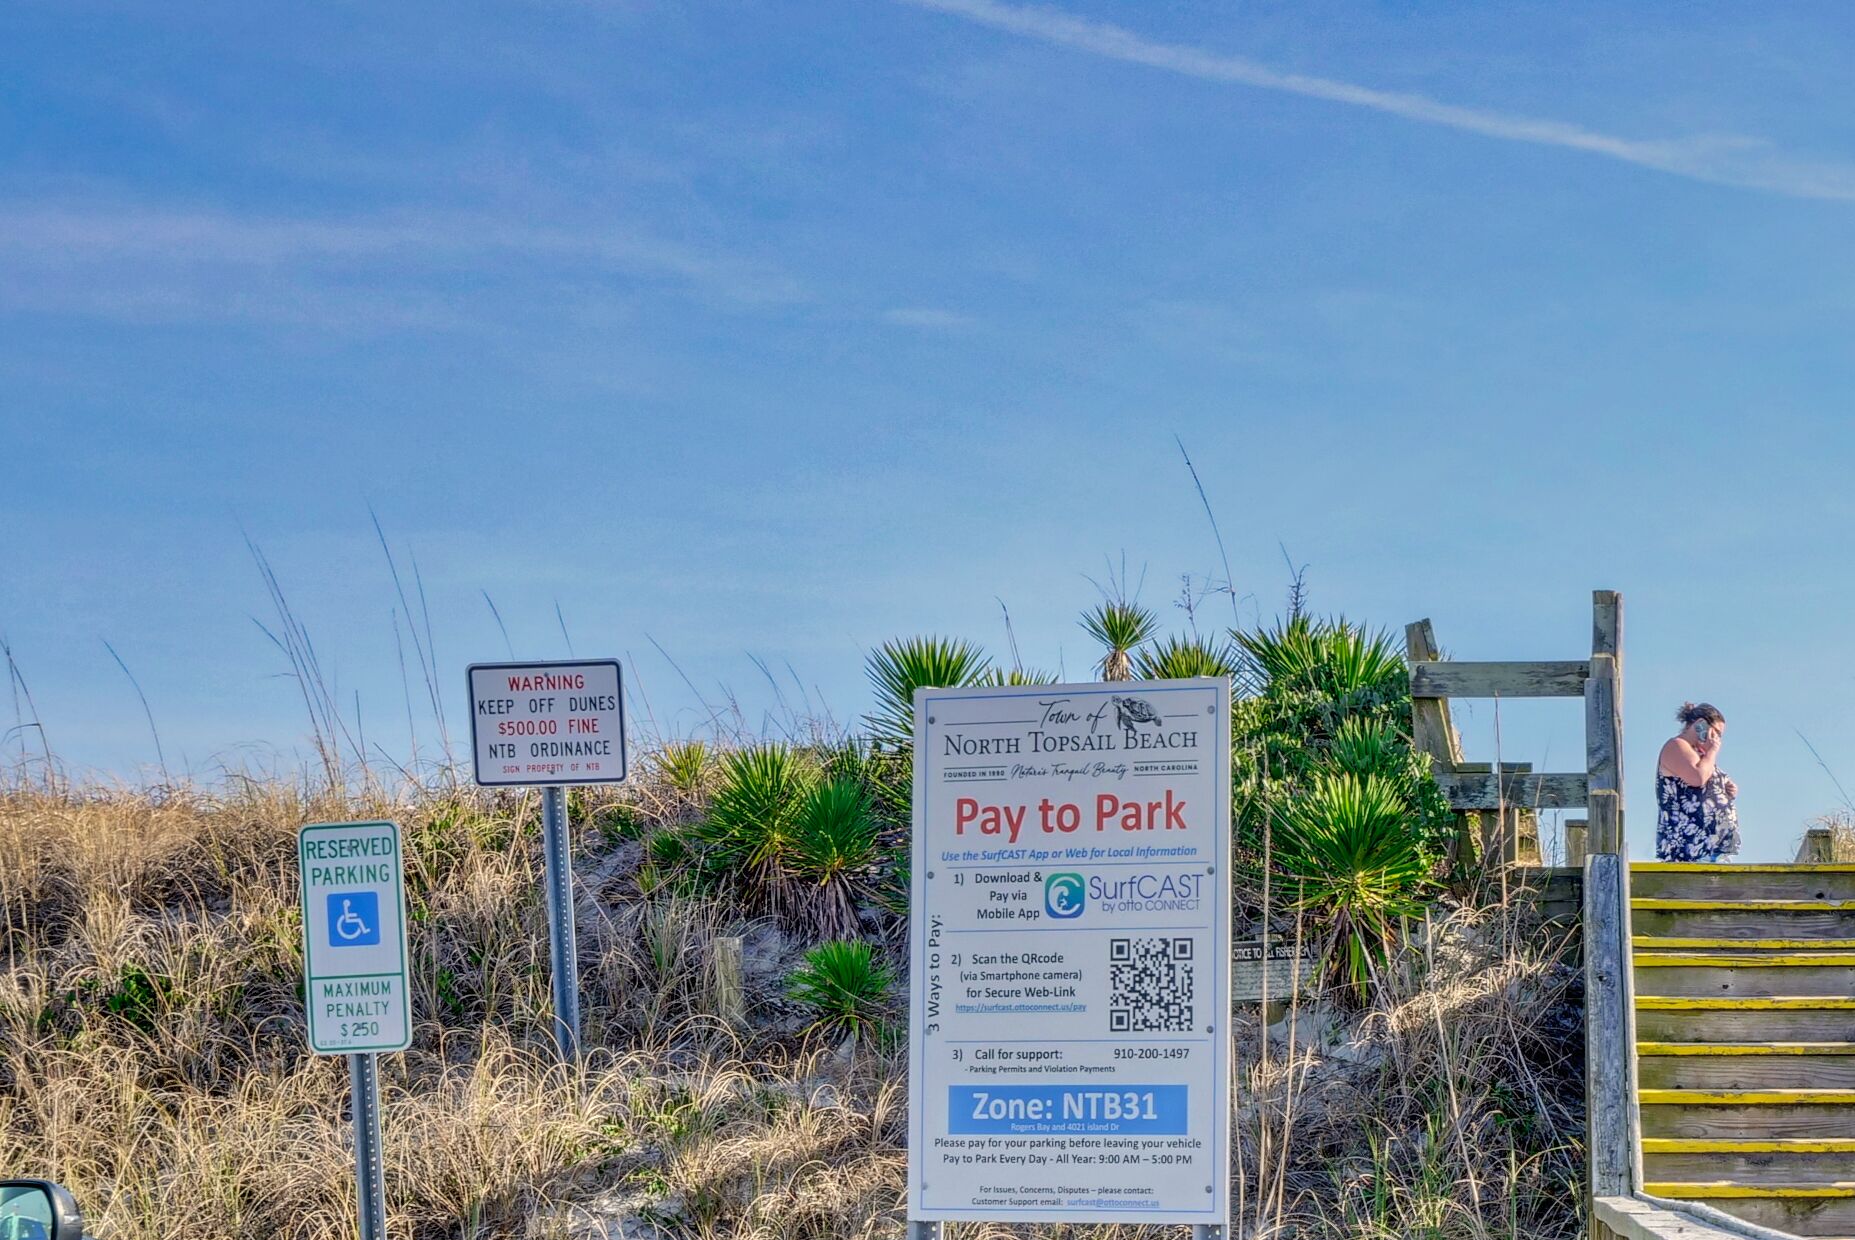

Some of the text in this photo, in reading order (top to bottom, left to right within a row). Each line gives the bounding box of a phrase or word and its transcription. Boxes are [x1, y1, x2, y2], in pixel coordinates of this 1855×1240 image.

[508, 675, 585, 691] WARNING
[478, 696, 615, 715] KEEP OFF DUNES
[1039, 700, 1109, 734] Town of
[499, 719, 599, 735] $500.00 FINE
[489, 740, 610, 758] NTB ORDINANCE
[944, 731, 1197, 755] NORTH TOPSAIL BEACH
[502, 762, 600, 774] SIGN PROPERTY OF NTB
[1051, 762, 1090, 781] Tranquil
[1092, 762, 1128, 780] Beauty
[956, 789, 1187, 843] Pay to Park
[306, 837, 393, 860] RESERVED
[941, 846, 1197, 862] Use the SurfCAST App or Web for Local Information
[312, 864, 390, 886] PARKING
[954, 871, 1043, 887] 1) Download &
[1089, 874, 1204, 900] SurfCAST
[990, 890, 1027, 903] Pay via
[977, 907, 1040, 922] Mobile App
[1102, 899, 1200, 914] by otto CONNECT
[952, 952, 1063, 966] 2) Scan the QRcode
[1252, 947, 1262, 959] TO
[928, 914, 943, 1032] 3 Ways to Pay:
[960, 970, 1082, 982] (via Smartphone camera)
[323, 981, 391, 998] MAXIMUM
[967, 986, 1075, 998] for Secure Web-Link
[327, 1001, 390, 1017] PENALTY
[953, 1049, 1062, 1061] 3) Call for support:
[1113, 1048, 1190, 1060] 910-200-1497
[969, 1064, 1116, 1075] Parking Permits and Violation Payments
[972, 1092, 1157, 1121] Zone: NTB31
[1010, 1122, 1036, 1133] Rogers
[1036, 1122, 1051, 1133] Bay
[1051, 1122, 1066, 1132] and
[1066, 1122, 1086, 1133] 4021
[1110, 1122, 1120, 1131] Dr
[934, 1137, 1202, 1151] Please pay for your parking before leaving your vehicle
[944, 1153, 1193, 1165] Pay to Park Every Day All Year: 9:00 AM 5:00 PM
[979, 1185, 1154, 1196] For Issues, Concerns, Disputes please contact:
[971, 1197, 1008, 1206] Customer
[1008, 1197, 1039, 1208] Support
[1039, 1197, 1064, 1206] email:
